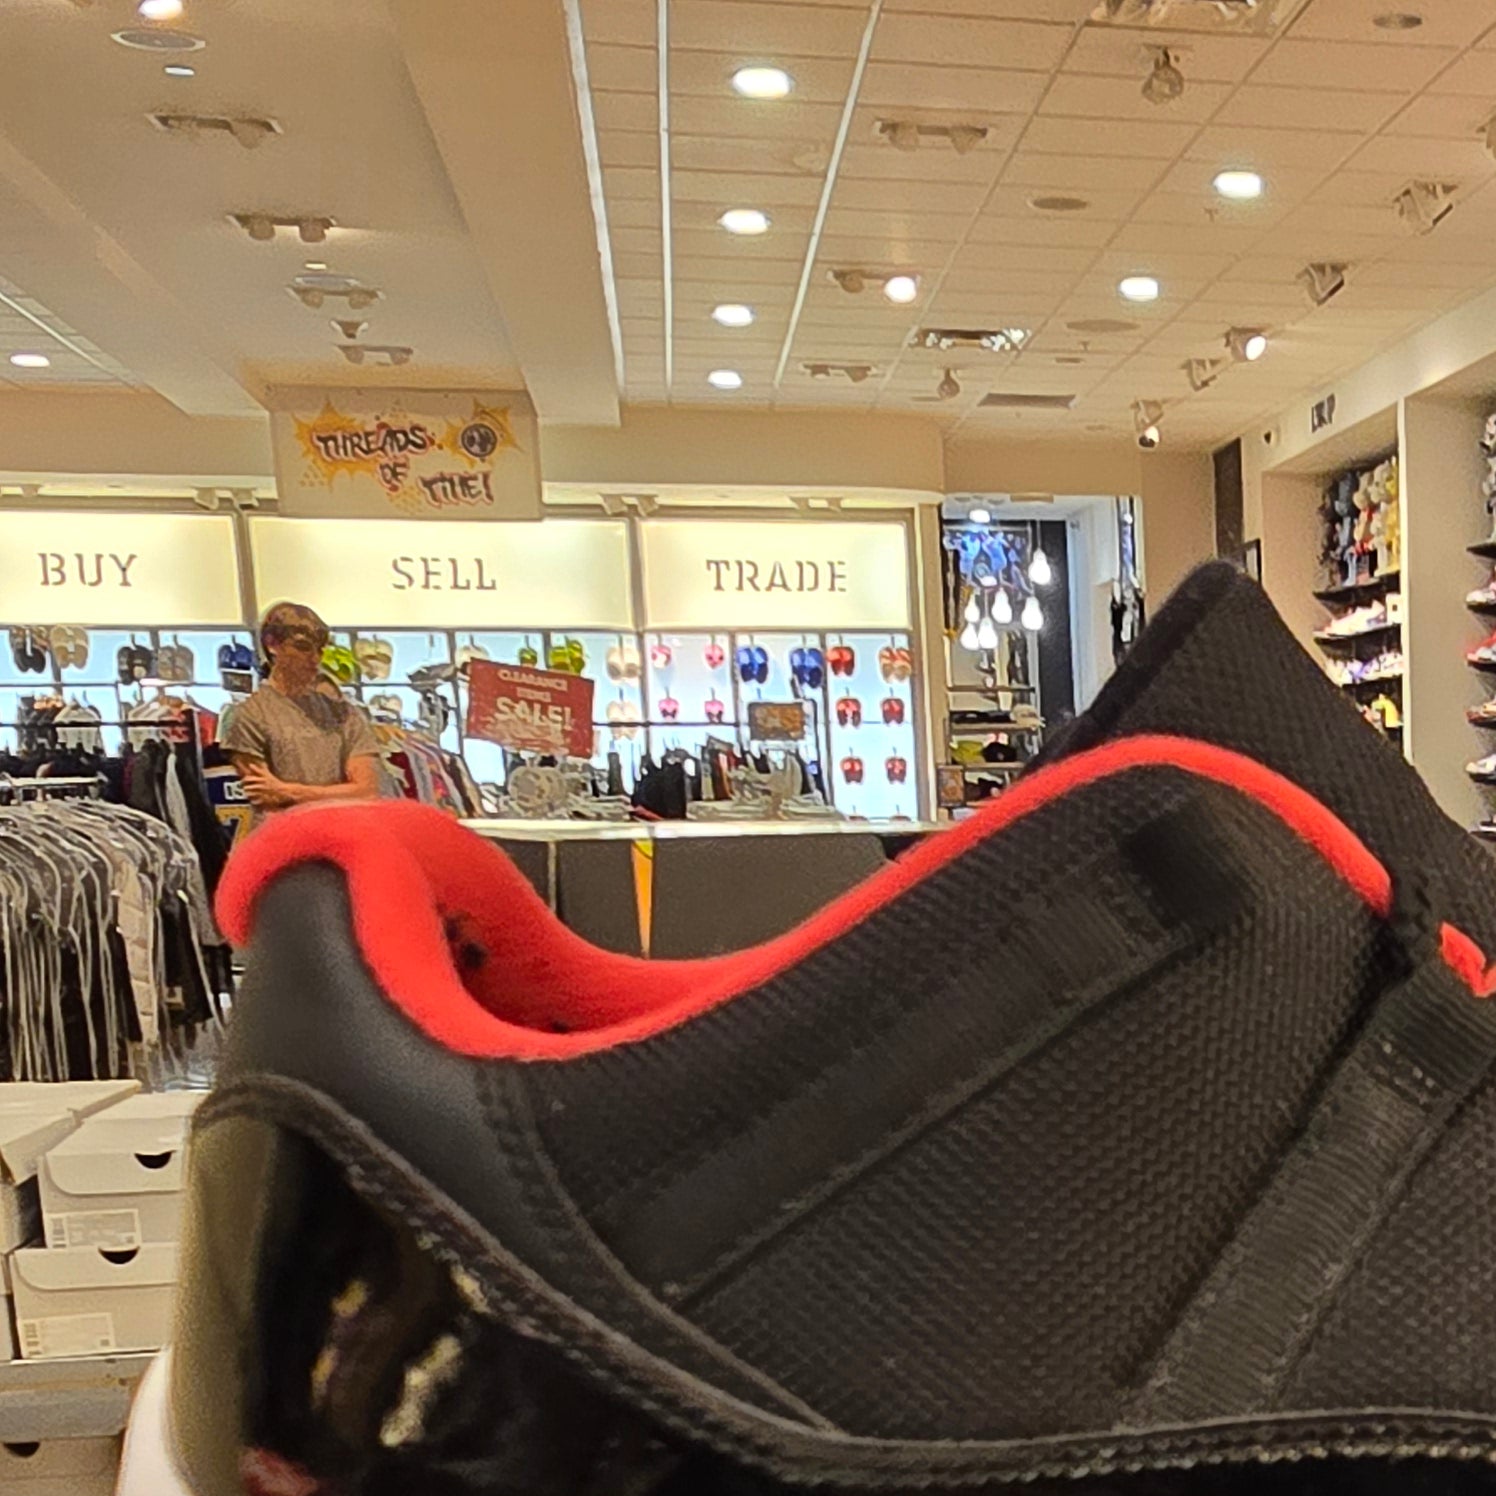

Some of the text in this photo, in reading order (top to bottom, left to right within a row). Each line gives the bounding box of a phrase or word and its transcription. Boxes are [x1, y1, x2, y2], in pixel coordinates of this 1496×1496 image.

[314, 426, 428, 459] THREADS
[379, 460, 408, 486] OF
[37, 552, 138, 588] BUY
[391, 556, 497, 591] SELL
[706, 559, 848, 593] TRADE
[494, 696, 573, 732] SALE!
